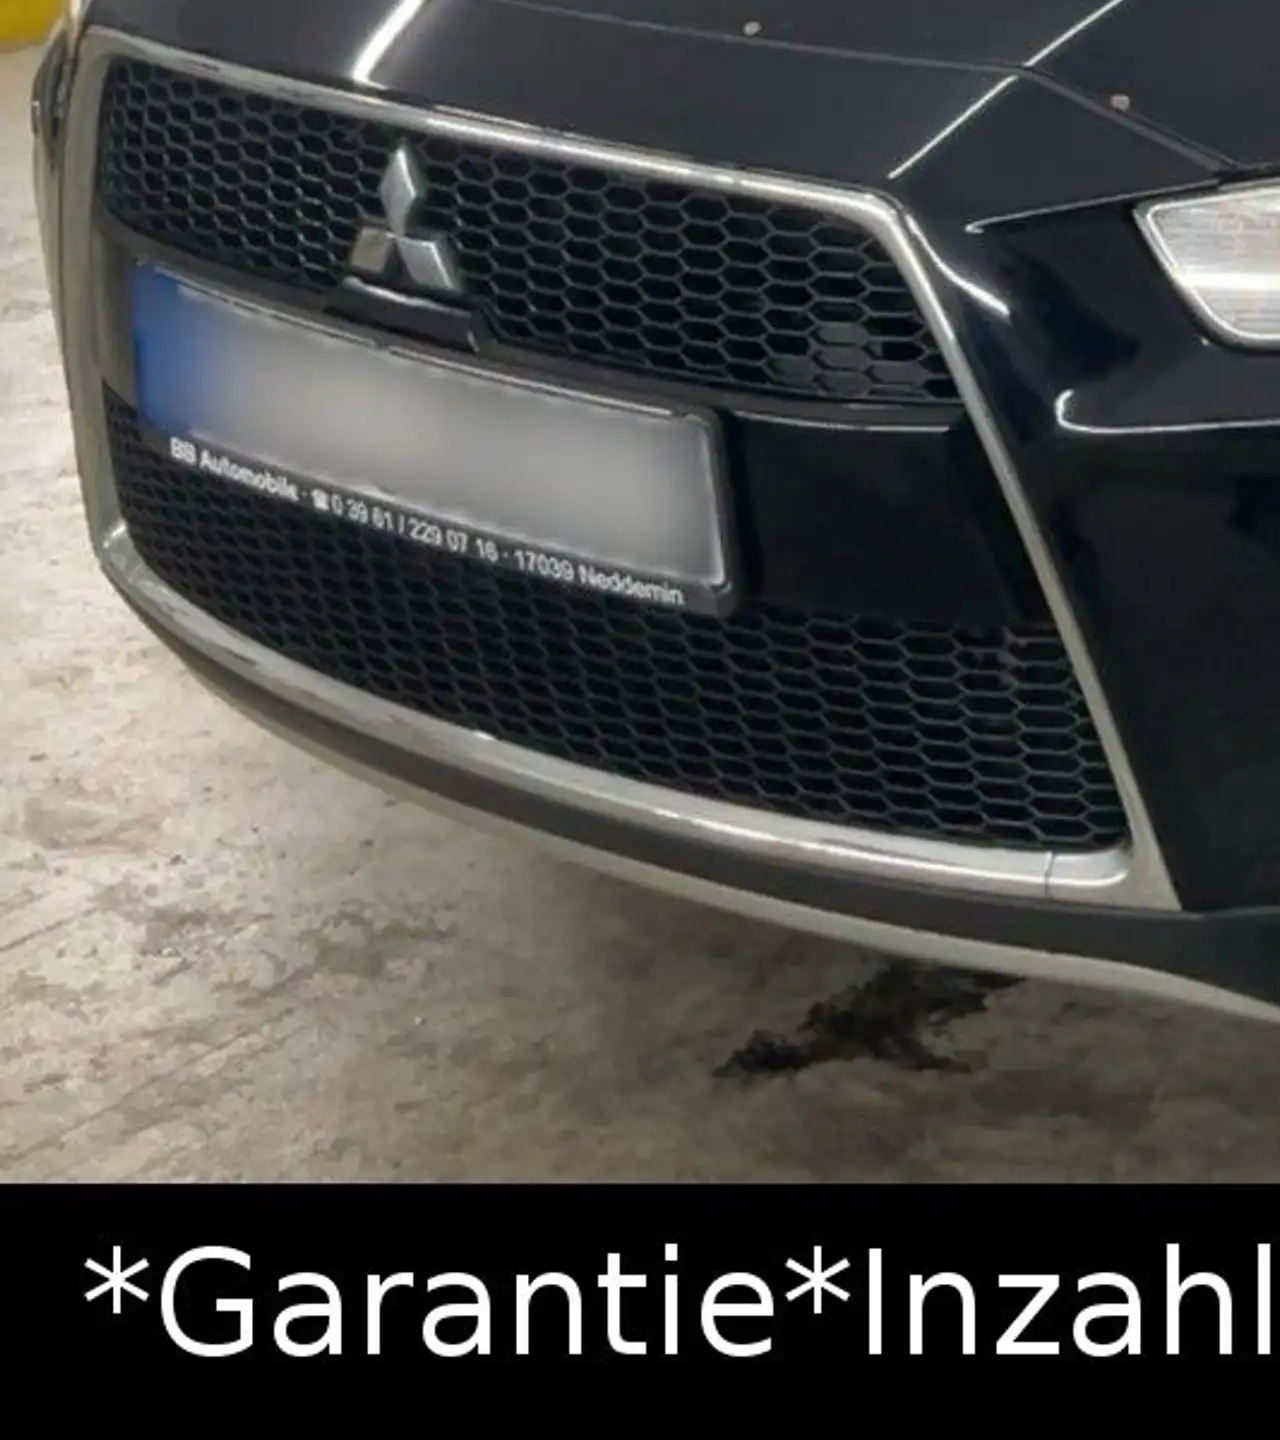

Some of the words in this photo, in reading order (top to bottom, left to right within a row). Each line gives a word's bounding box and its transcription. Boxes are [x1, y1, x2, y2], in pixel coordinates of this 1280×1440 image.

[199, 447, 299, 502] Automobile
[346, 498, 369, 524] 39
[410, 517, 442, 546] 229
[446, 528, 468, 553] 07
[514, 548, 575, 581] 17039
[578, 564, 686, 607] Neddemin
